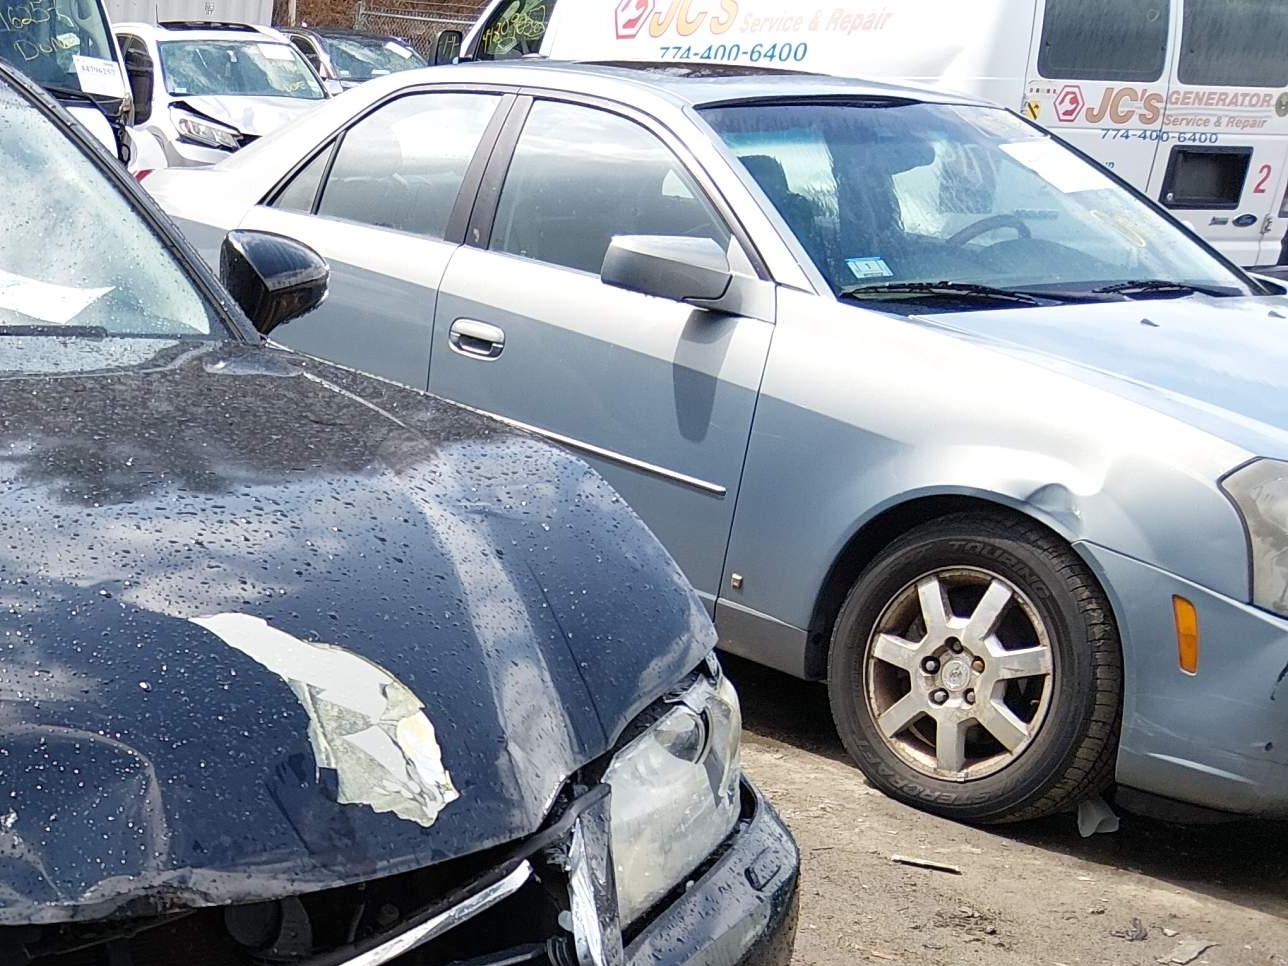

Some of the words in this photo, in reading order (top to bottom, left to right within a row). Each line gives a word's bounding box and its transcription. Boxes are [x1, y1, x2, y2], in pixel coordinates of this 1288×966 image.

[739, 12, 803, 33] Service
[808, 13, 822, 32] &
[825, 9, 892, 36] Repair
[660, 42, 808, 62] 774-400-6400
[1168, 91, 1274, 108] GENERATOR
[1164, 115, 1211, 127] Service
[1213, 116, 1223, 128] &
[1225, 116, 1268, 130] Repair
[1101, 129, 1219, 144] 774-400-6400
[1253, 164, 1272, 194] 2
[948, 540, 1050, 599] TOURING
